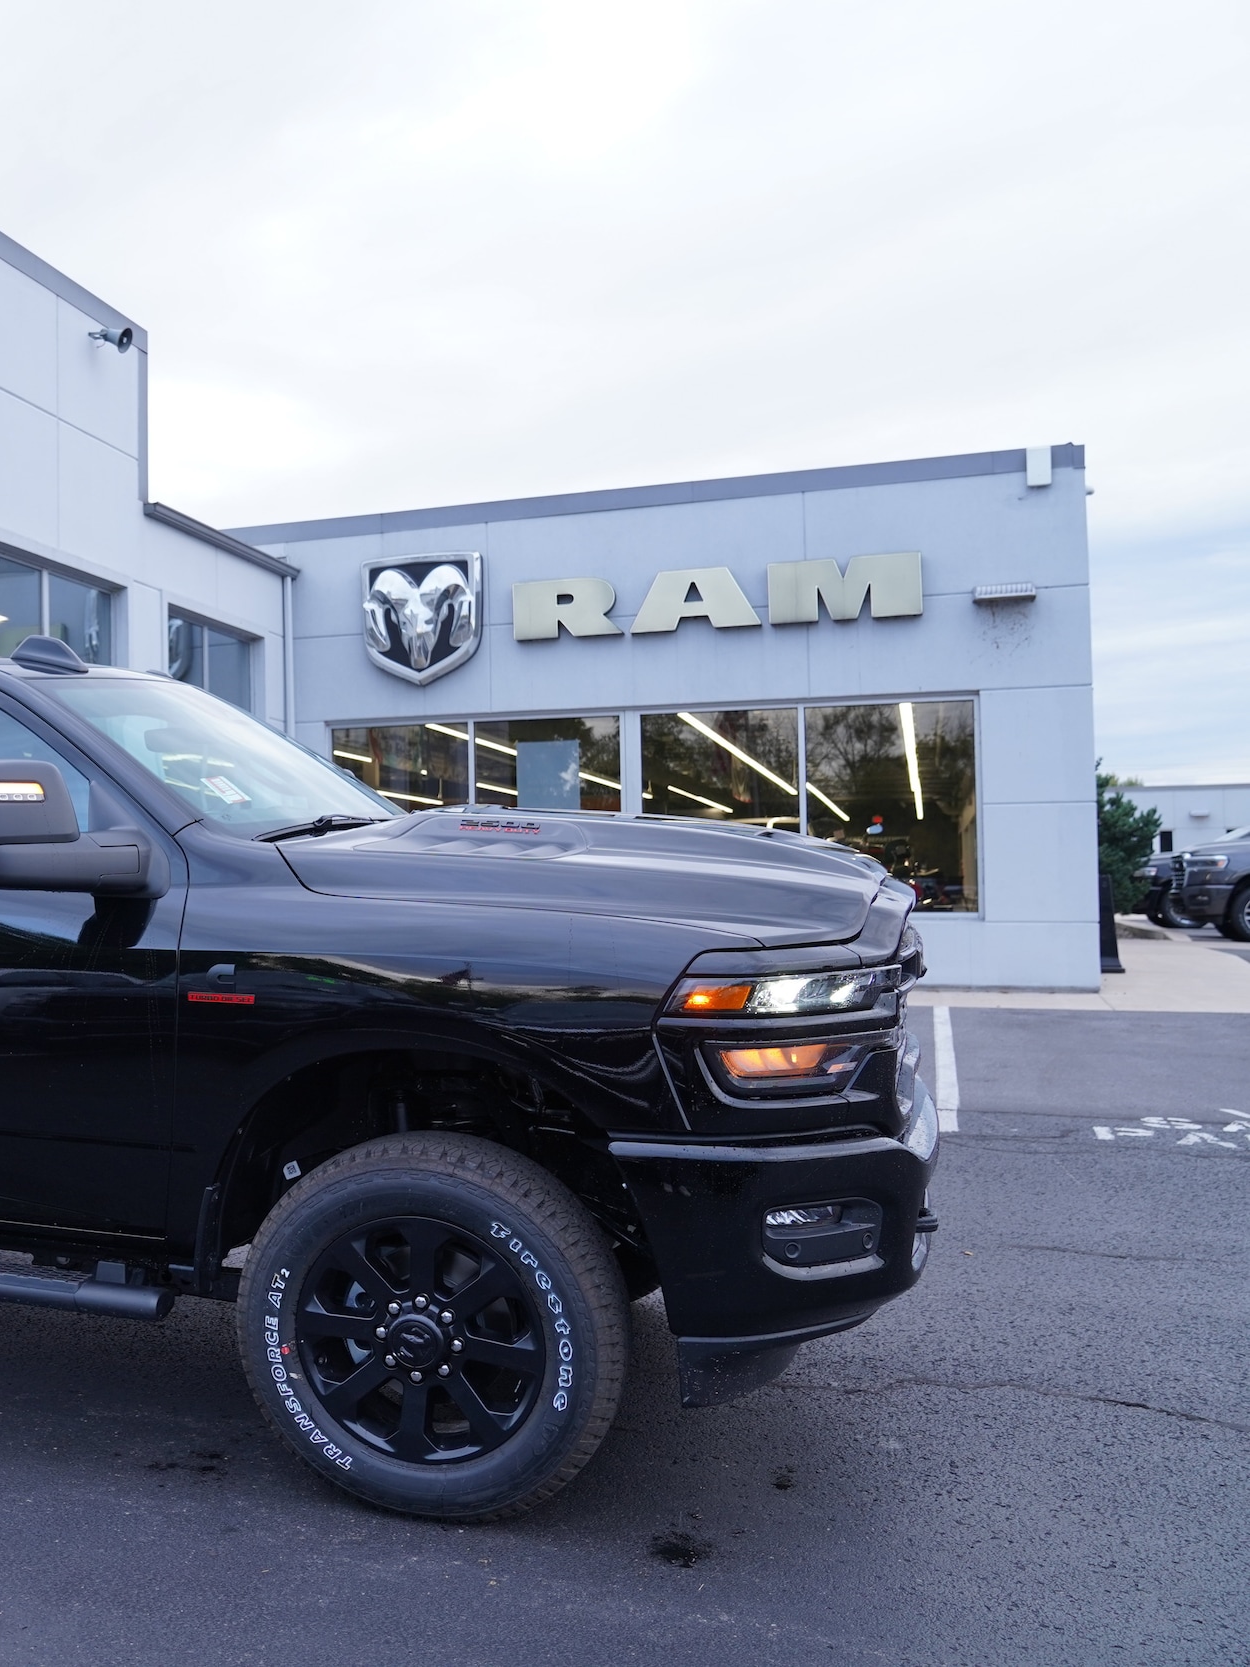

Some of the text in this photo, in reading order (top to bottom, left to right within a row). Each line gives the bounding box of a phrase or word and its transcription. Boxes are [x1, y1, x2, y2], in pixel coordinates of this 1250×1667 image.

[512, 550, 924, 642] RAM
[503, 827, 541, 835] DUTY
[490, 1222, 573, 1411] Firestone
[264, 1314, 354, 1471] TRANSFORCE
